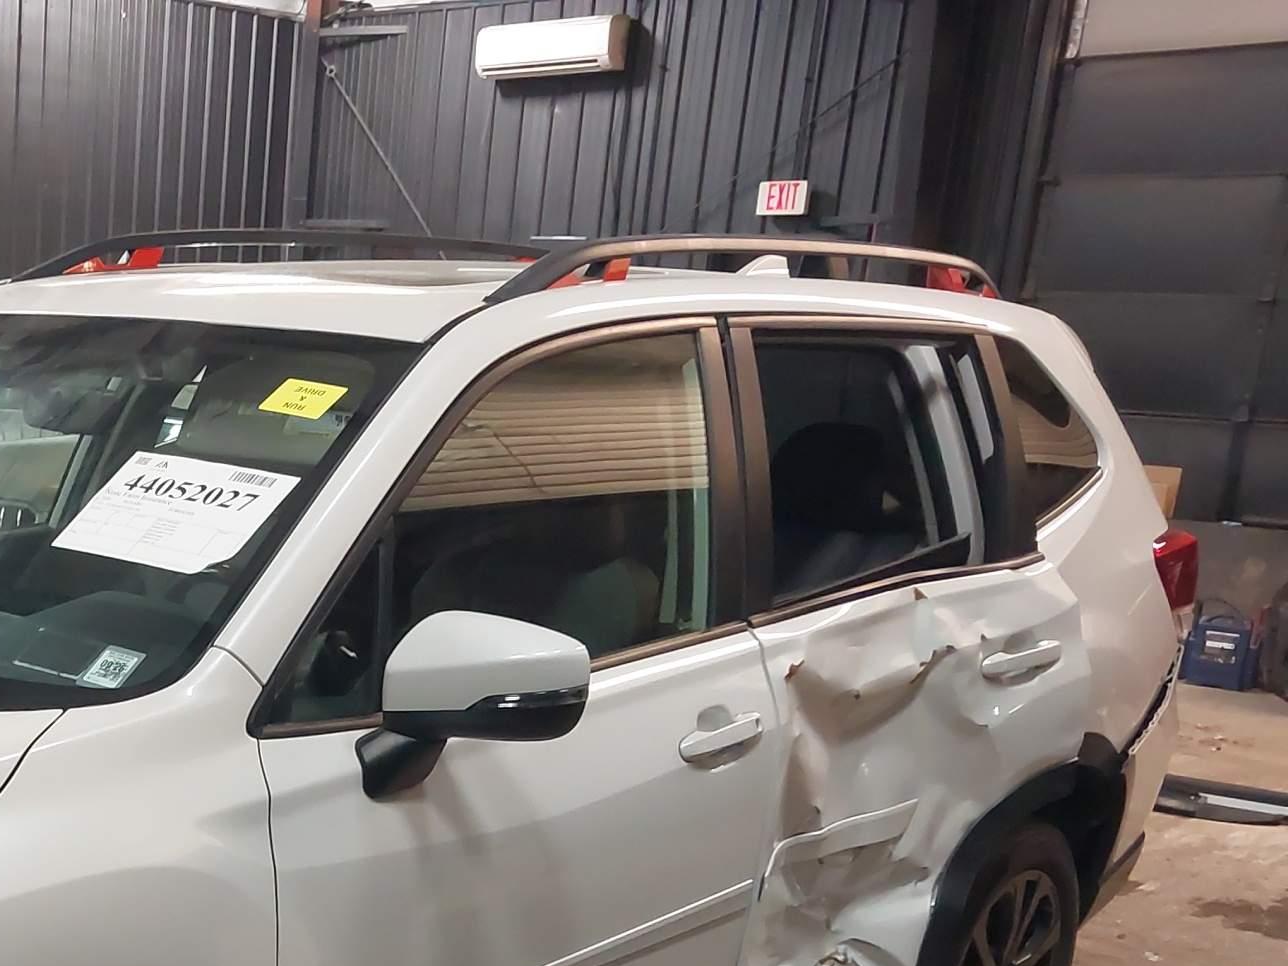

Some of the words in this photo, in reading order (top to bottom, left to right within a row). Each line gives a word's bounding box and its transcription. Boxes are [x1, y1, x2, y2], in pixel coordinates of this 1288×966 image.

[766, 182, 801, 210] EXIT
[294, 385, 327, 397] DRIVE
[282, 401, 307, 411] RUN
[123, 473, 262, 512] 44052027
